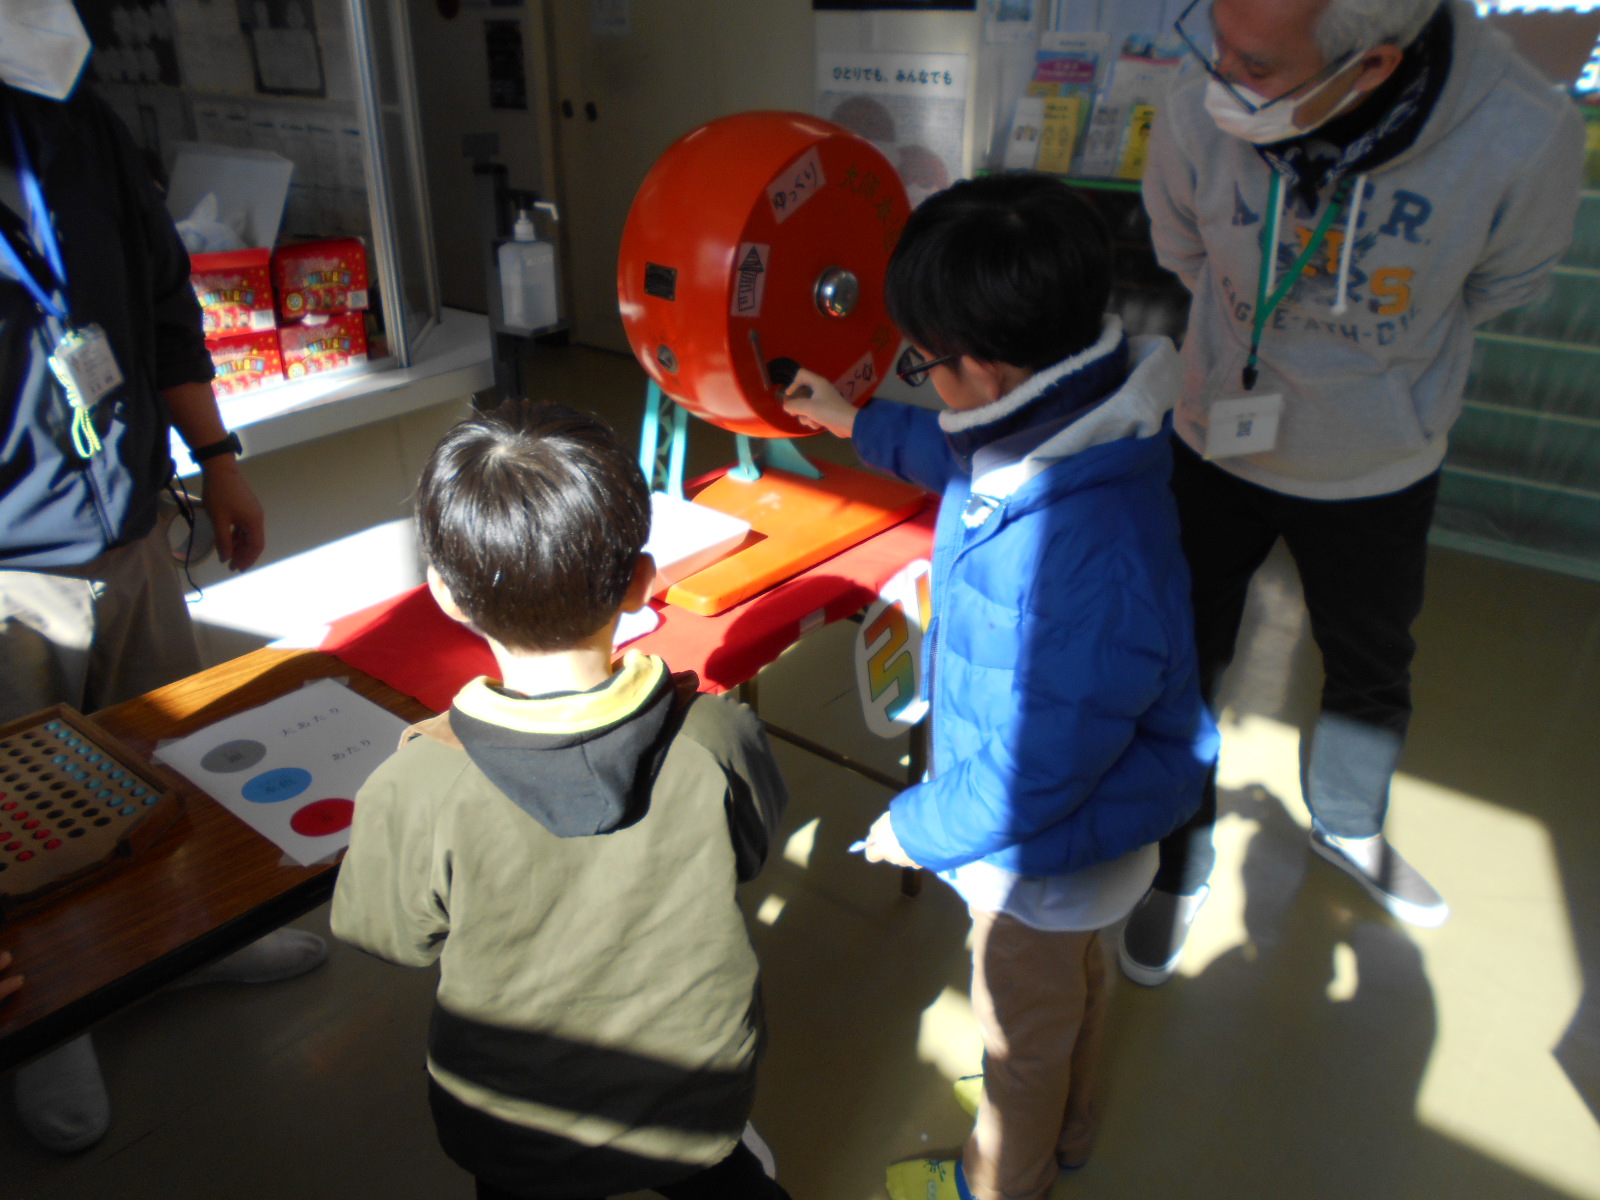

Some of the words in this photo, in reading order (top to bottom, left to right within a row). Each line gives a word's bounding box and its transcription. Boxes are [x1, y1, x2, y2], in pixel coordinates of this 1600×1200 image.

[773, 161, 819, 211] ゆっくり
[332, 739, 370, 761] あたり
